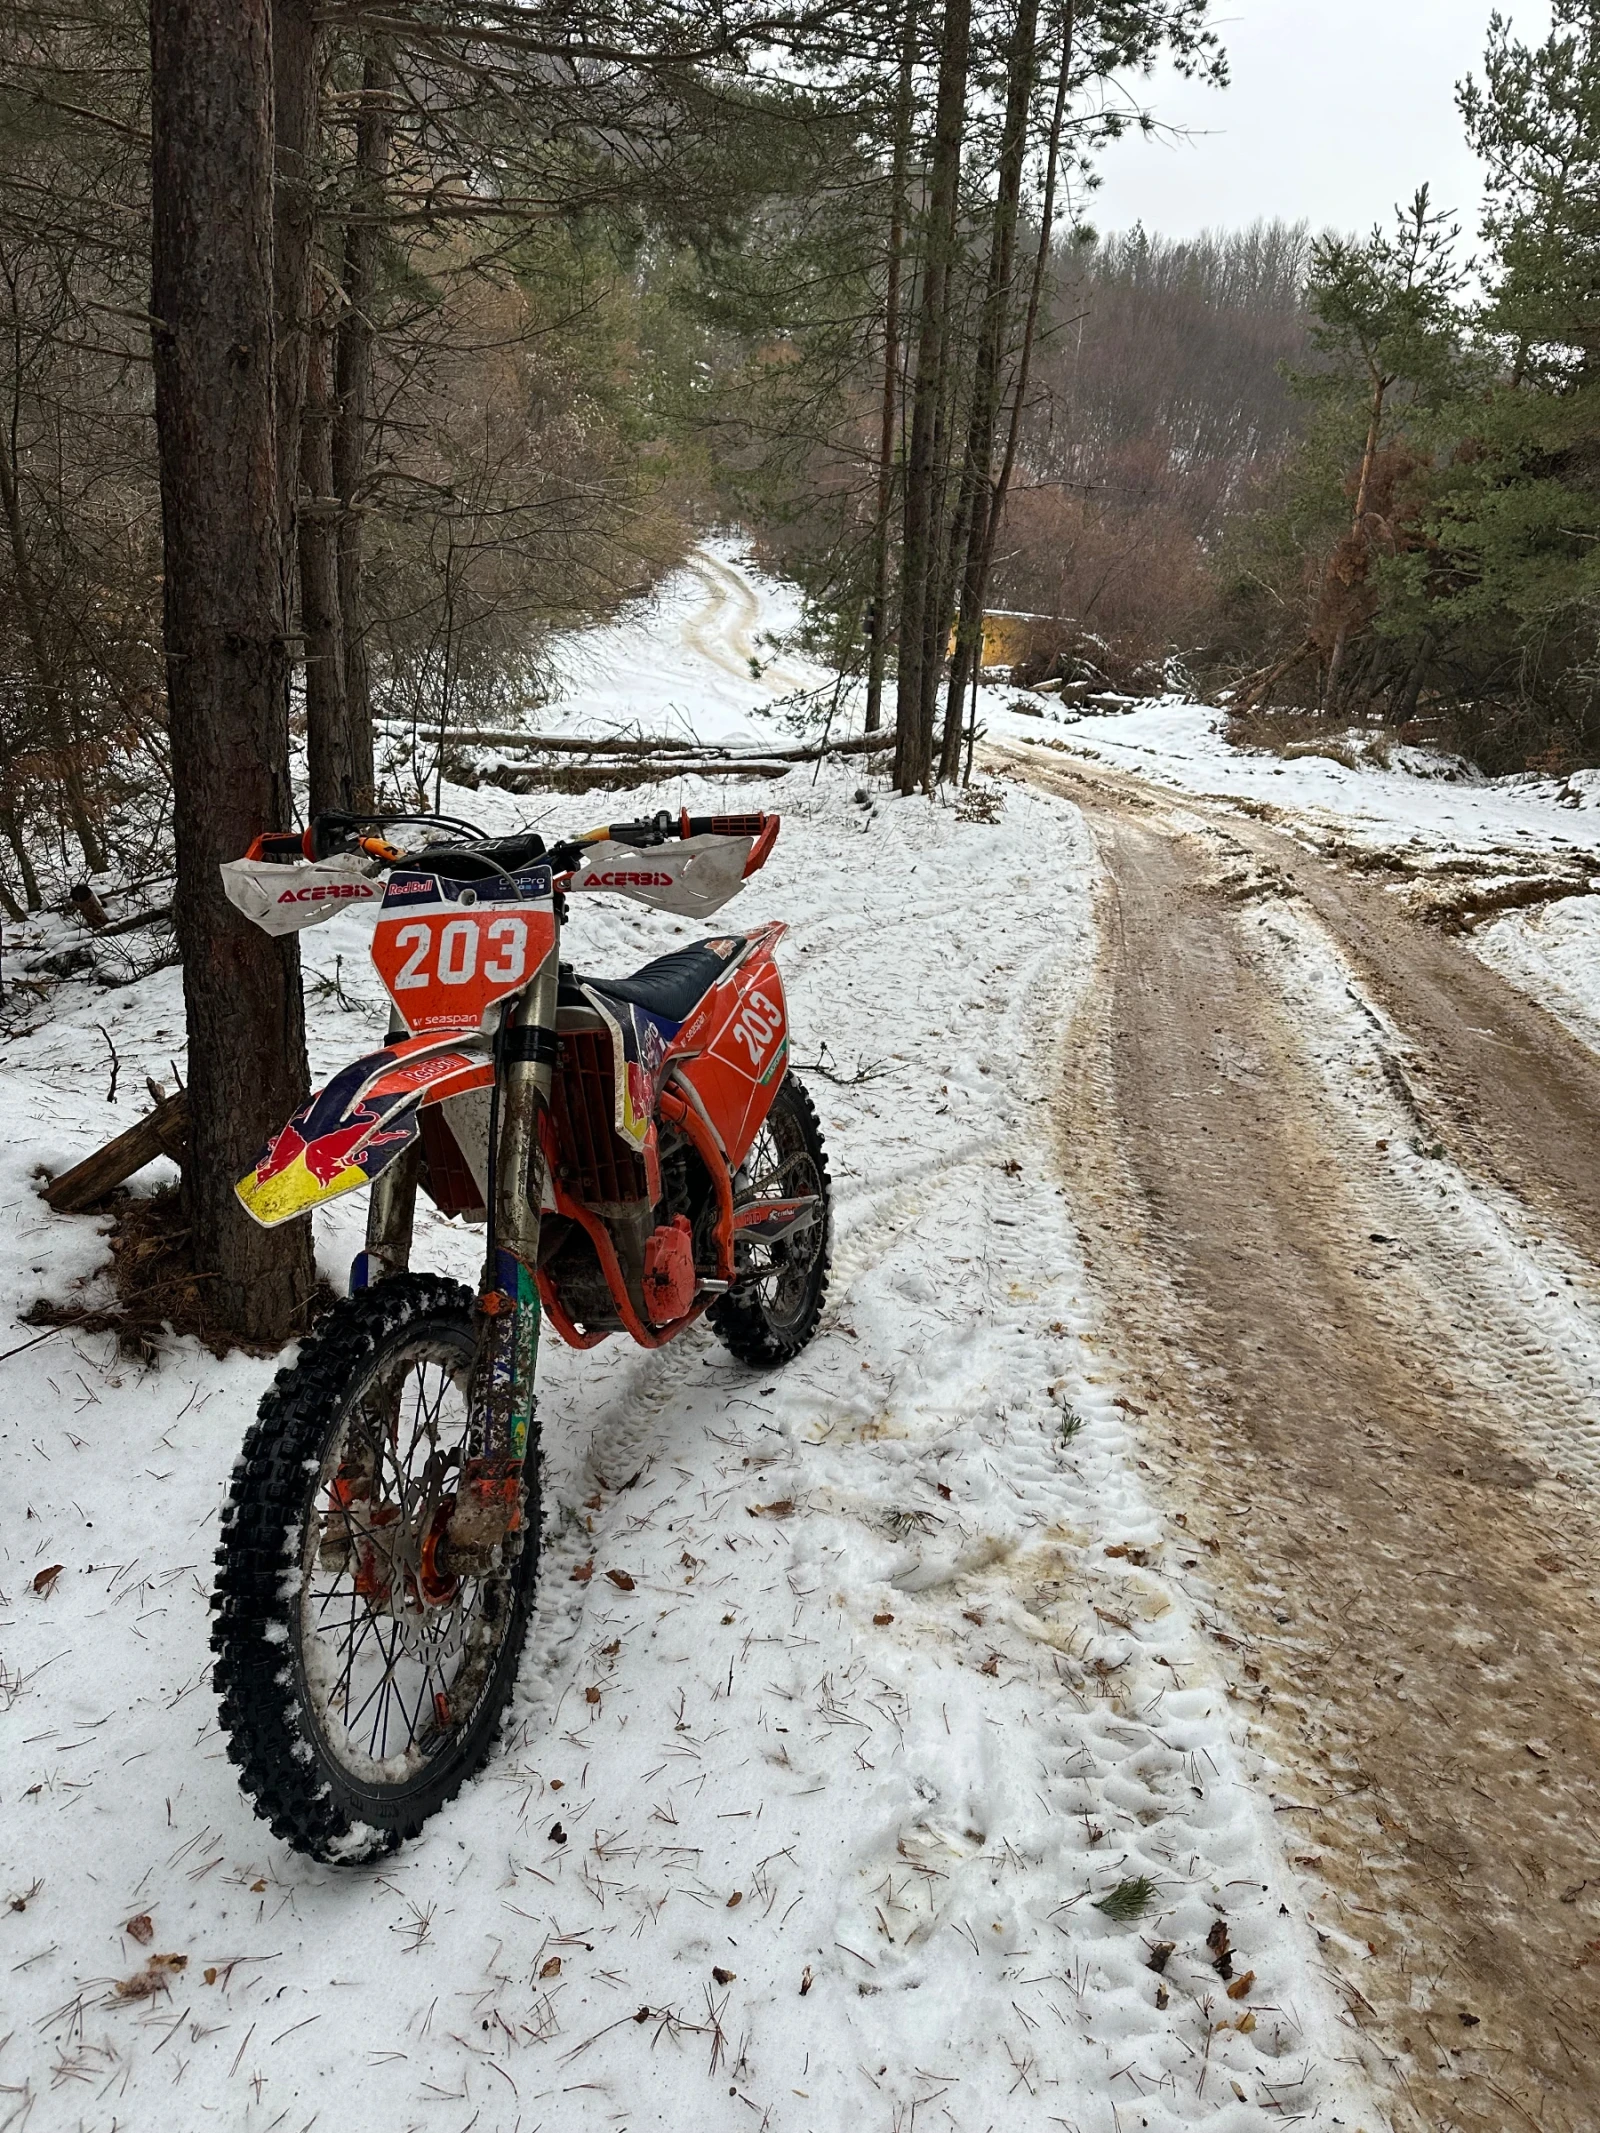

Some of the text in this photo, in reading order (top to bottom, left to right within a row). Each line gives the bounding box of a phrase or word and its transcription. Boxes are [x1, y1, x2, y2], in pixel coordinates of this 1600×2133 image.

[583, 872, 673, 887] ACERBIS
[277, 884, 374, 903] ACERBIS
[394, 917, 528, 990] 203
[425, 1014, 478, 1025] seaspan
[733, 991, 782, 1066] 203
